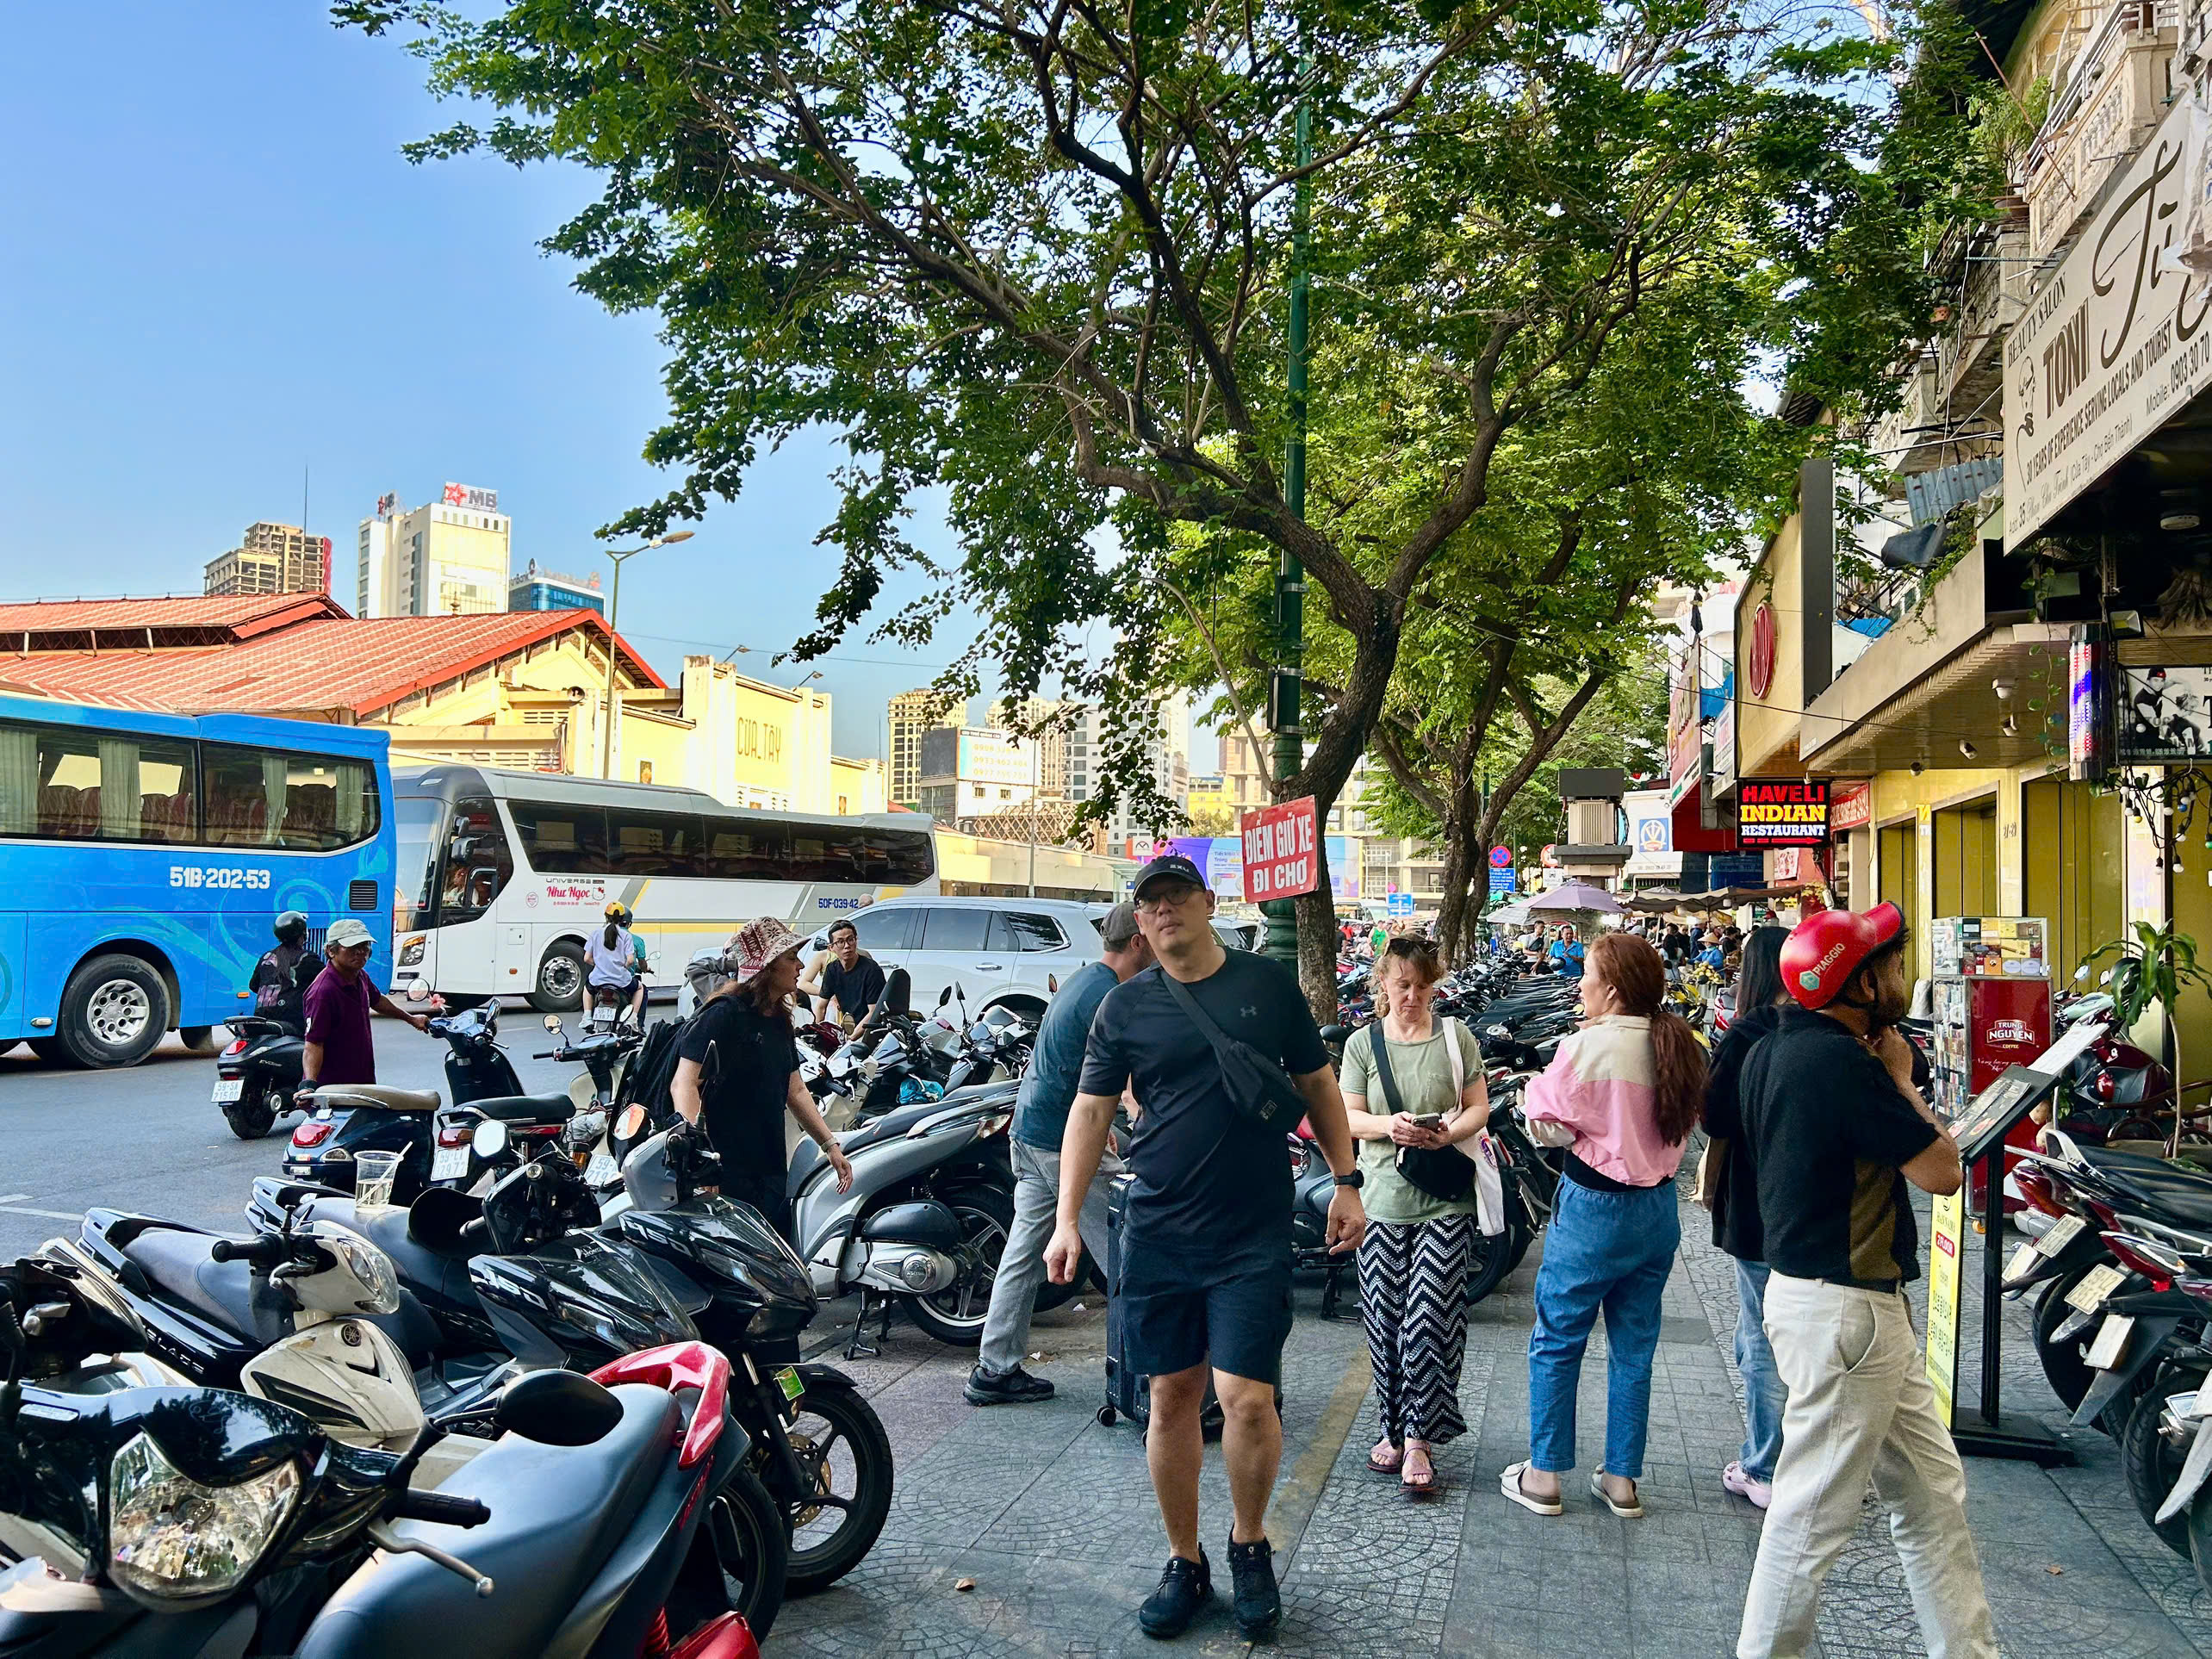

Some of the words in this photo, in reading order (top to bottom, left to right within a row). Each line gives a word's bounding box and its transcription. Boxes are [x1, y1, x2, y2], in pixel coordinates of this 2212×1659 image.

[2008, 309, 2037, 369] BEAUTY
[2039, 272, 2066, 329] SALON
[2043, 297, 2090, 419] TONI
[2147, 384, 2169, 416] Mobile:
[2171, 352, 2188, 394] 0903
[2190, 342, 2198, 376] 30
[2200, 331, 2209, 366] 70
[2033, 444, 2047, 477] YEARS
[2047, 438, 2054, 465] OF
[2054, 413, 2083, 458] EXPERIENCE
[2085, 385, 2107, 427] SERVING
[2108, 362, 2129, 407] LOCALS
[2131, 349, 2143, 386] AND
[2145, 319, 2171, 370] TOURIST
[469, 489, 496, 508] MB
[1743, 785, 1824, 802] HAVELI
[1740, 805, 1826, 822] INDIAN
[1741, 824, 1826, 836] RESTAURANT
[1245, 812, 1274, 865] ĐIỂM
[1277, 811, 1296, 858] GIỮ
[1297, 814, 1313, 854] XE
[1253, 867, 1269, 893] ĐI
[1275, 856, 1307, 890] CHỢ
[546, 886, 567, 898] Như
[569, 886, 590, 901] Ngọc
[1812, 943, 1845, 975] PIAGGIO
